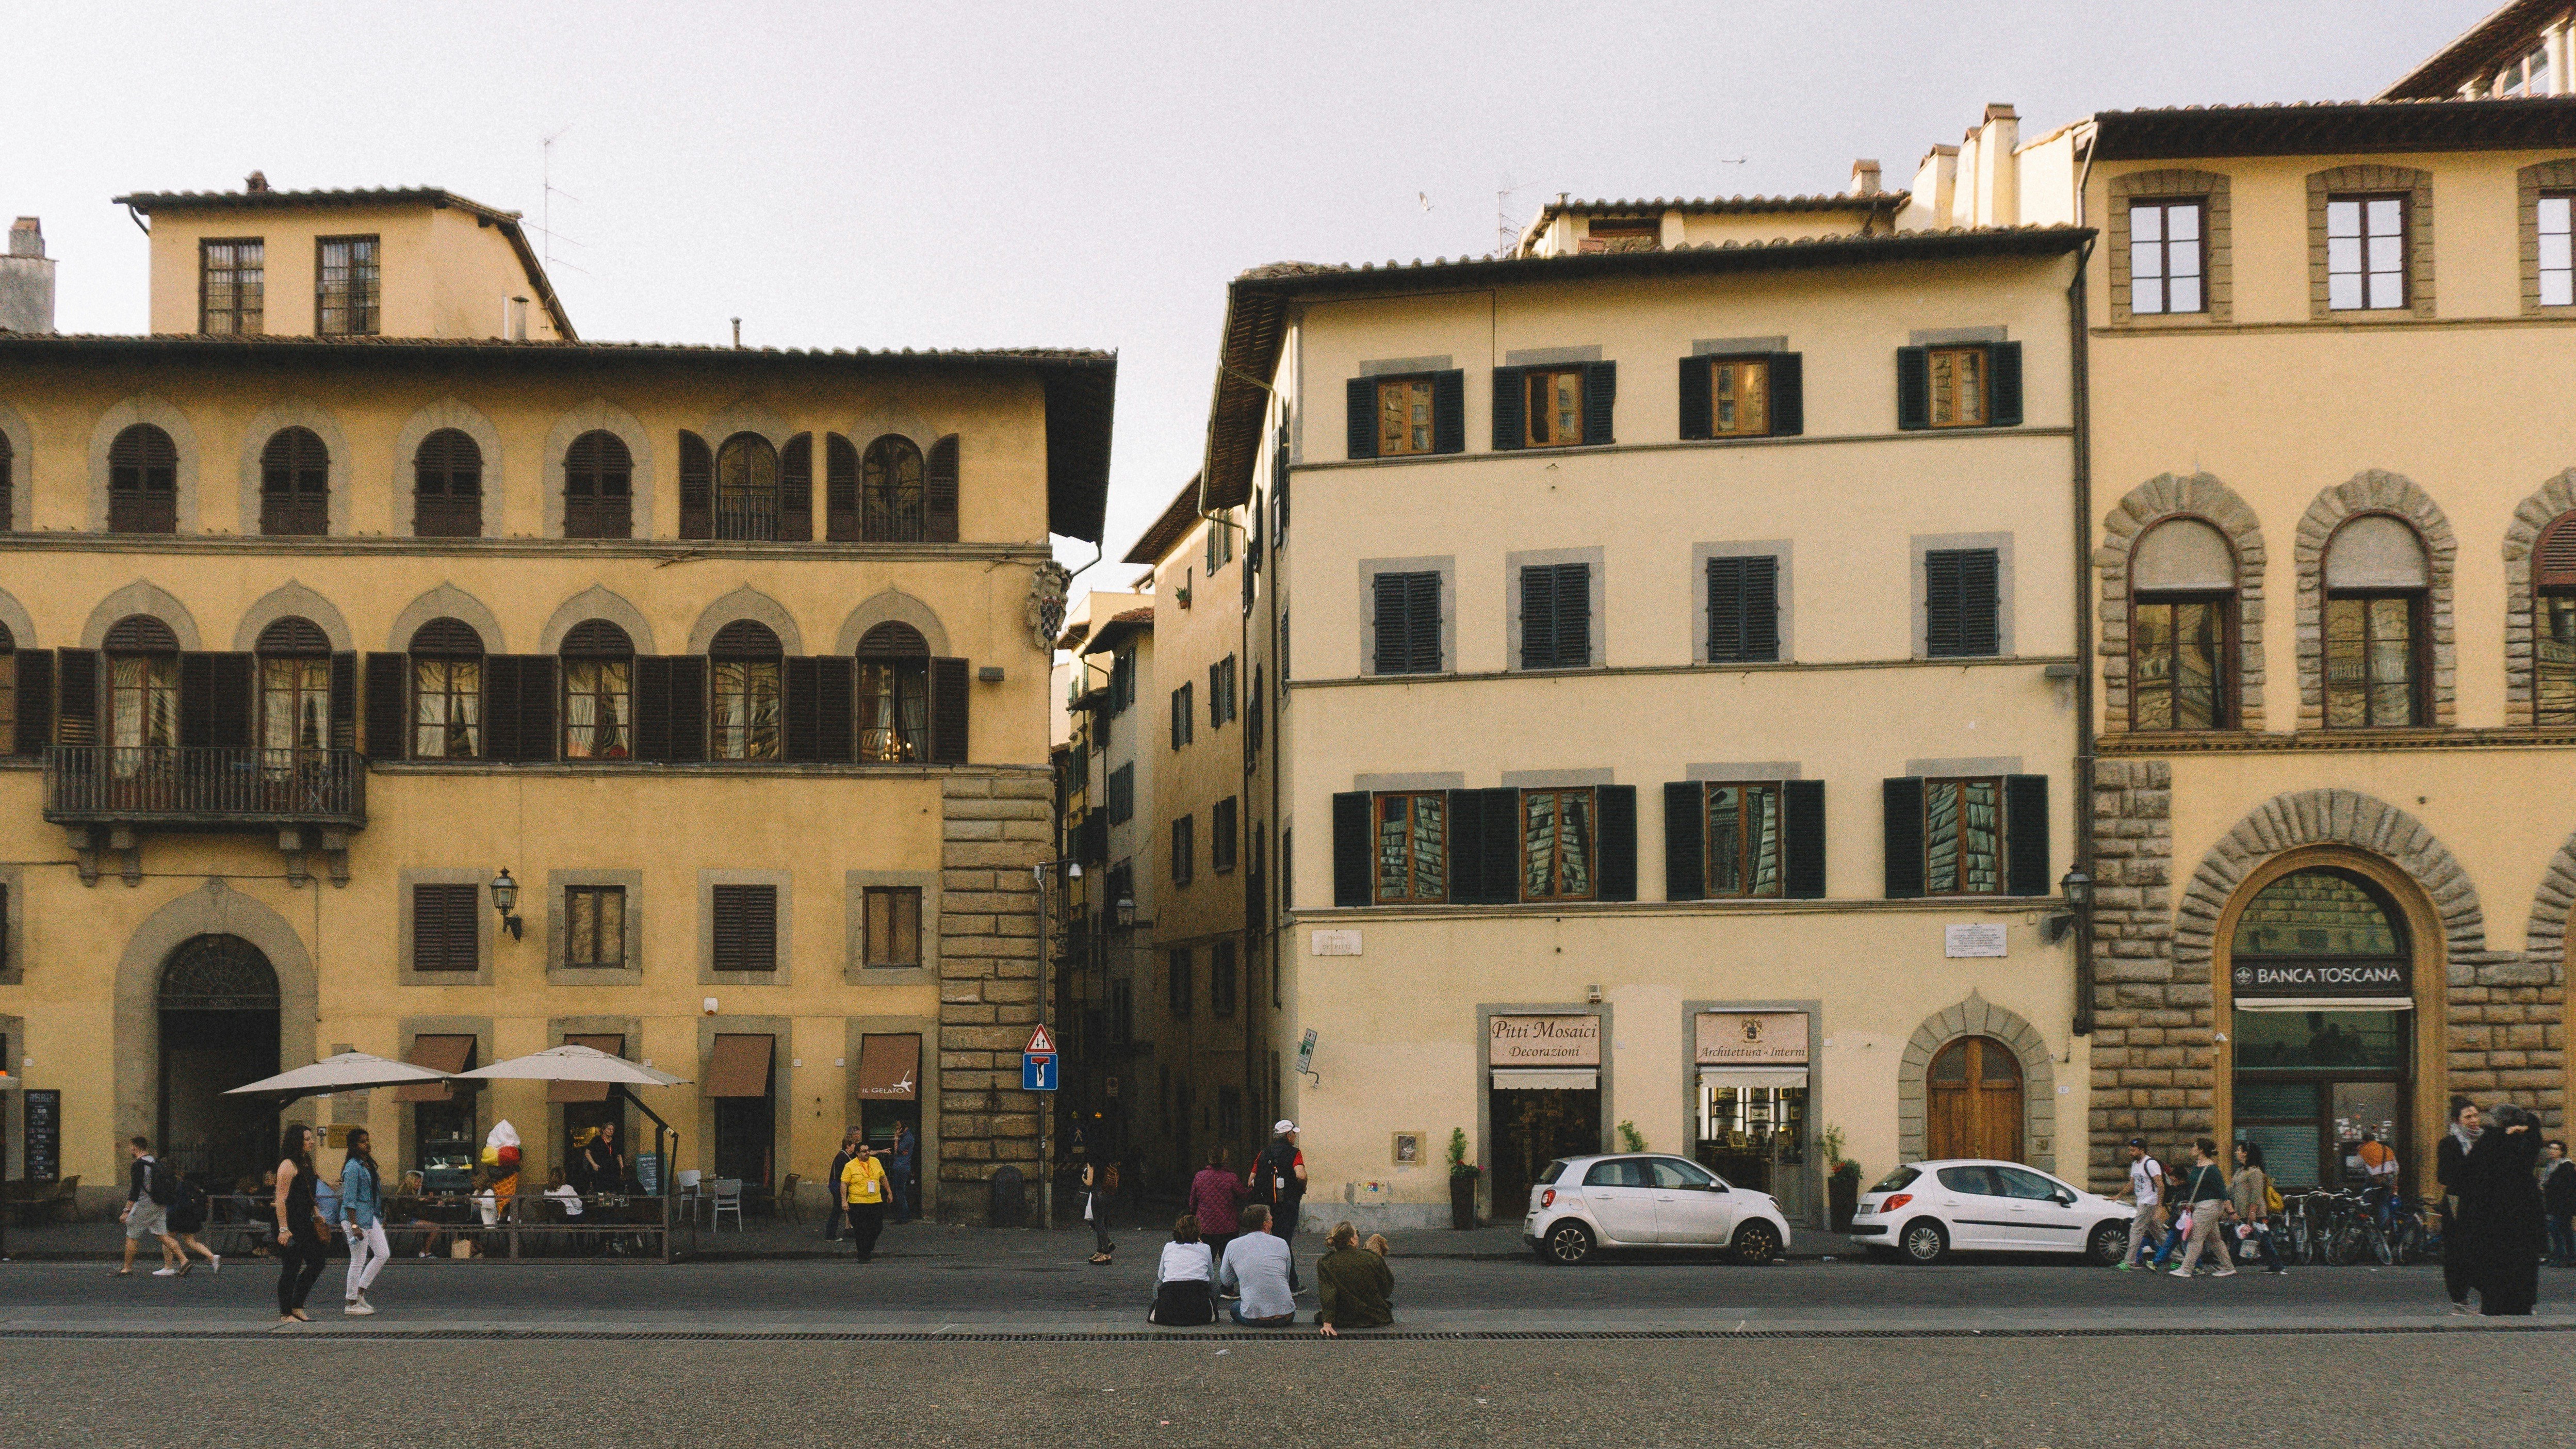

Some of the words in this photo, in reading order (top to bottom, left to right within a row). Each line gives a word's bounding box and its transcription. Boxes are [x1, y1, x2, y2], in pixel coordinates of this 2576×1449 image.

[2258, 968, 2316, 983] BANCA
[2319, 968, 2401, 983] TOSCANA
[1492, 1020, 1529, 1038] Pitti
[1532, 1021, 1597, 1038] Mosaici
[1509, 1046, 1580, 1057] Decorazioni
[1699, 1046, 1761, 1057] Architettura
[1770, 1047, 1806, 1056] Interni
